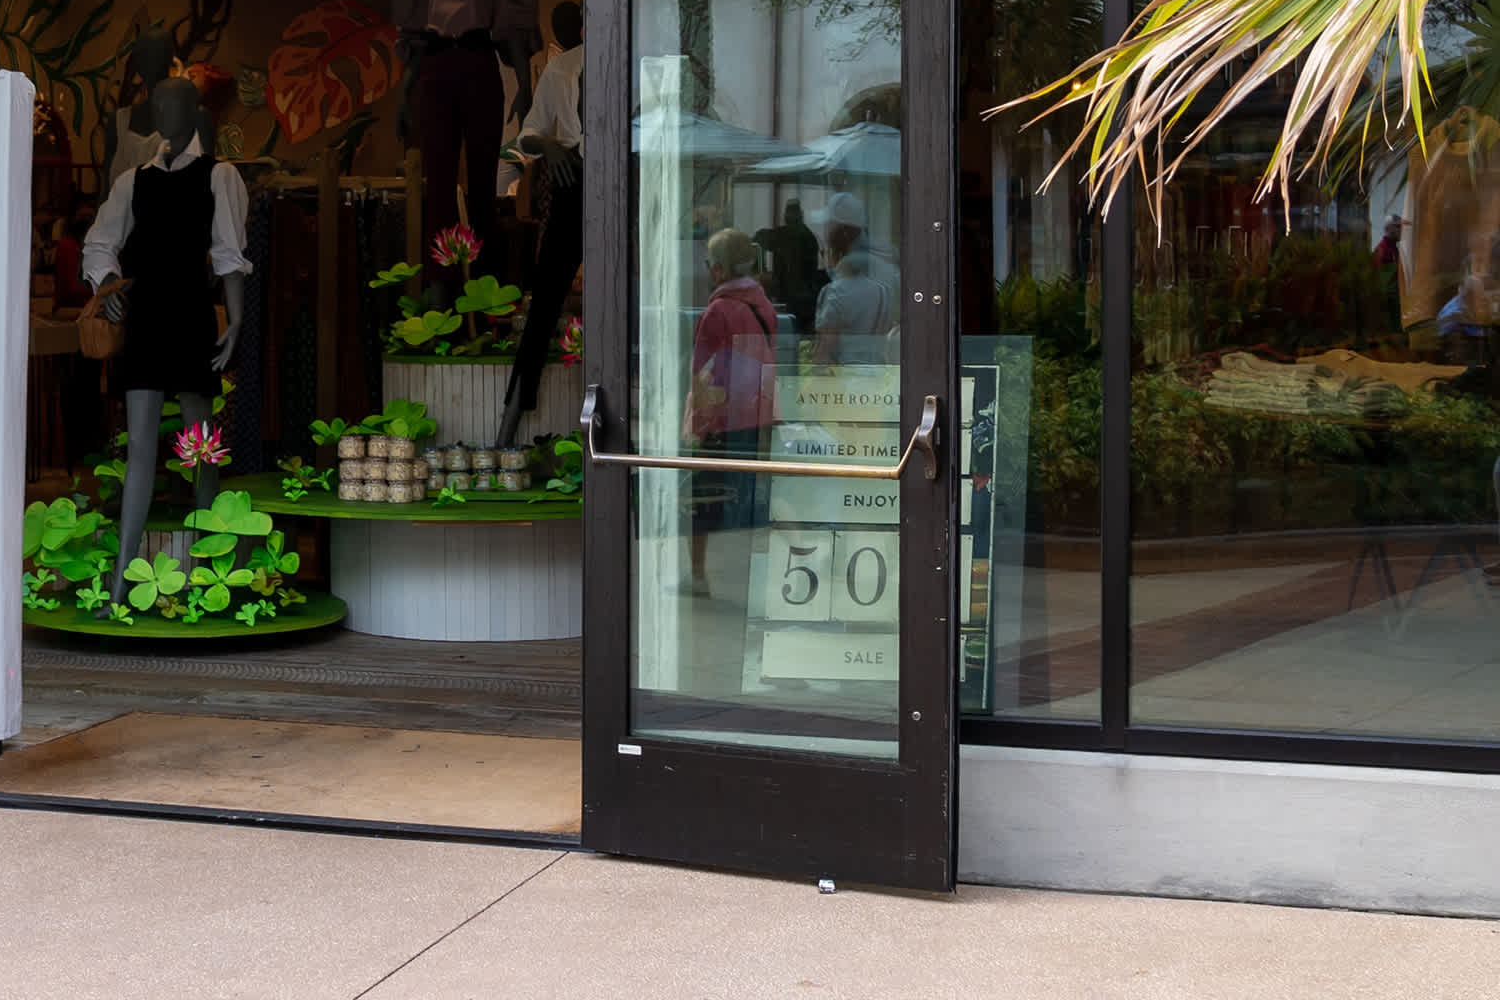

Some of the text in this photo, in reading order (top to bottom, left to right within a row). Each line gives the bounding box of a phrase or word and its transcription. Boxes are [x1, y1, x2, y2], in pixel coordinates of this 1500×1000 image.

[796, 443, 898, 457] LIMITED TIME
[843, 494, 898, 508] ENJOY
[781, 545, 888, 606] 50
[844, 651, 884, 665] SALE
